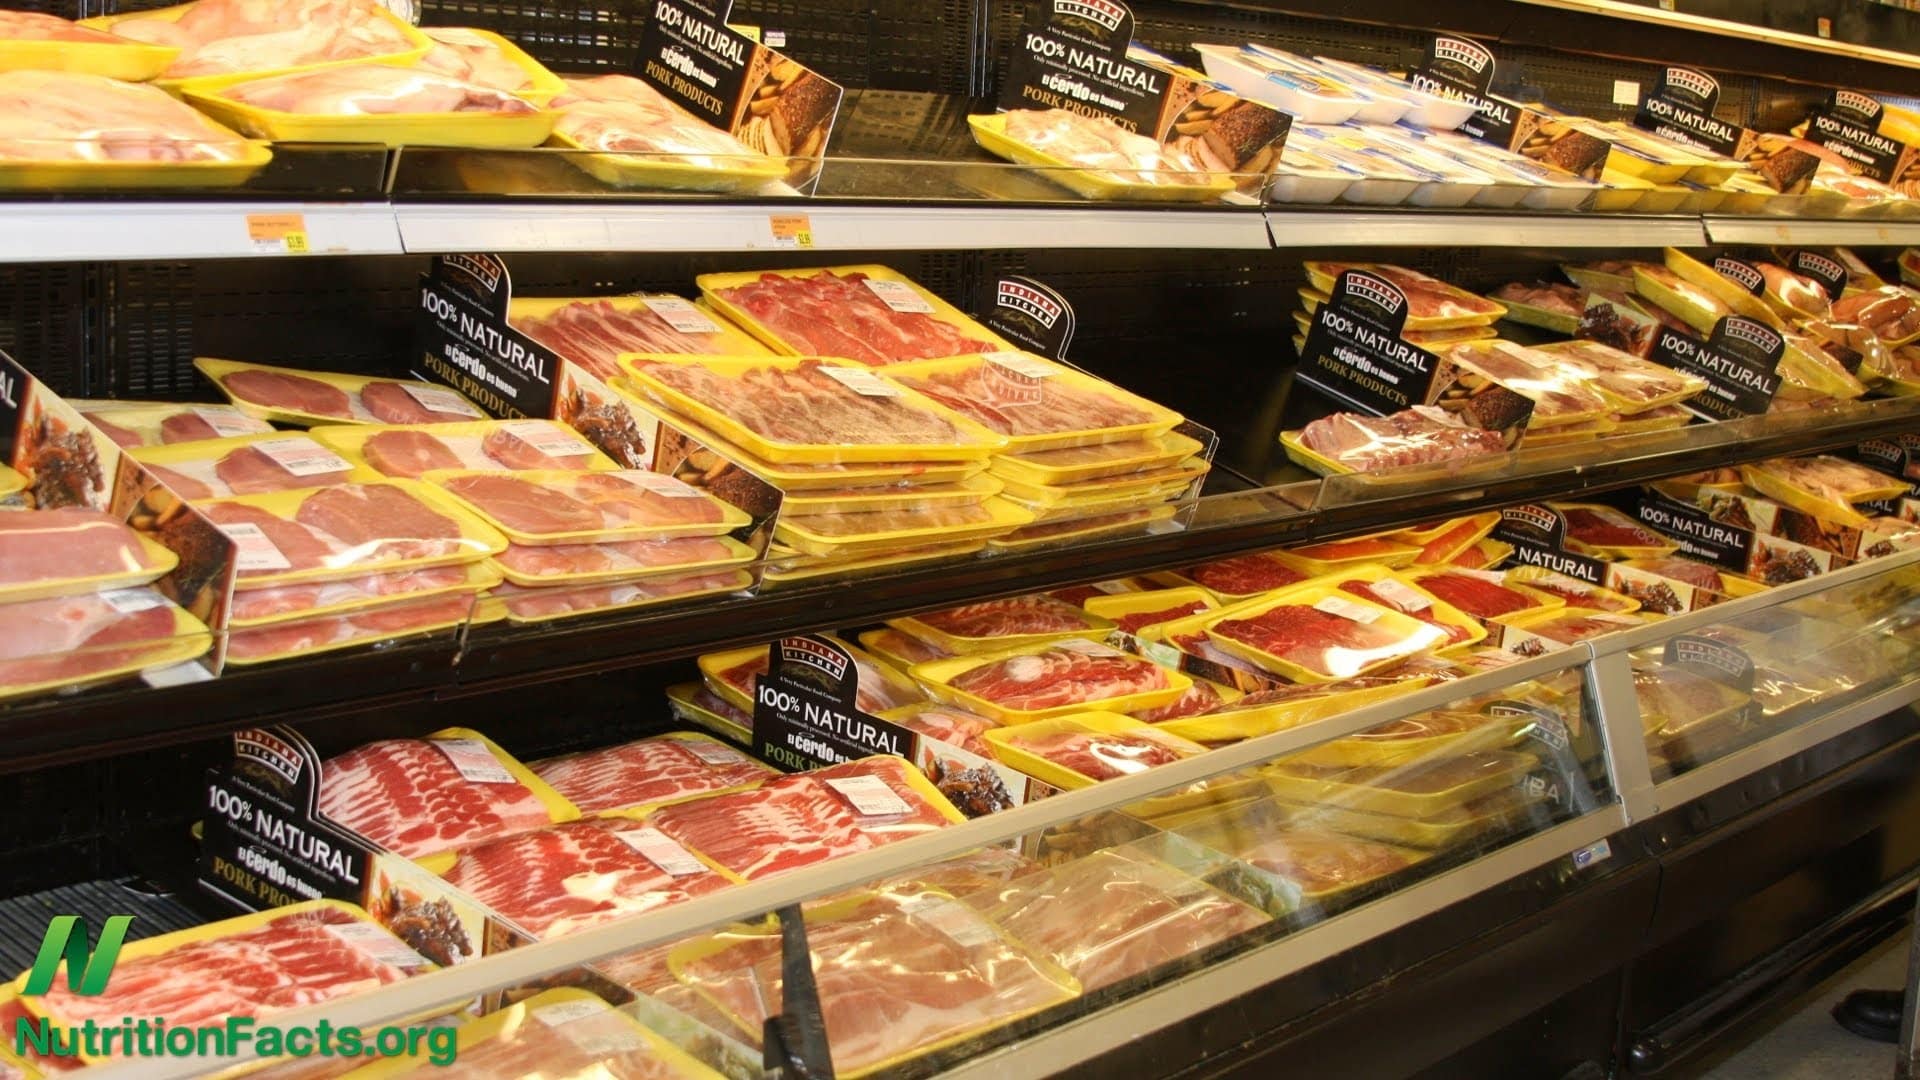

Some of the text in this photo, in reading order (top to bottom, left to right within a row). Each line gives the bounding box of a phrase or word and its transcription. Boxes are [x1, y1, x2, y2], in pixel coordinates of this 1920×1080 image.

[1058, 3, 1115, 26] KITCHEN
[655, 1, 684, 26] 100%
[681, 15, 745, 67] NATURAL
[1026, 33, 1160, 95] 100% NATURAL
[645, 60, 724, 116] PORK PRODUCTS
[1022, 85, 1064, 109] PORK
[1049, 75, 1091, 101] cerdo
[1646, 99, 1673, 116] 100%
[1673, 108, 1735, 142] NATURAL
[1841, 126, 1897, 155] NATURAL
[1000, 295, 1053, 325] KITCHEN
[1002, 284, 1057, 315] INDIANA
[421, 288, 457, 323] 100%
[460, 312, 550, 385] NATURAL
[1321, 310, 1353, 334] 100%
[1354, 326, 1428, 373] NATURAL
[423, 351, 460, 388] PORK
[451, 346, 487, 382] cerdo
[495, 374, 518, 399] bueno
[1338, 348, 1372, 374] cerdo
[1660, 333, 1696, 356] 100%
[1695, 349, 1773, 395] NATURAL
[1317, 354, 1408, 406] PORK PRODUCTS
[1640, 505, 1671, 524] 100%
[1671, 515, 1744, 549] NATURAL
[1518, 546, 1598, 582] NATURAL
[784, 639, 843, 666] INDIANA
[785, 650, 841, 677] KITCHEN
[758, 684, 905, 759] 100% NATURAL
[764, 742, 805, 771] PORK
[794, 734, 834, 762] cerdo
[209, 785, 252, 822] 100%
[255, 809, 360, 885] NATURAL
[213, 855, 257, 895] PORK
[245, 850, 287, 886] cerdo
